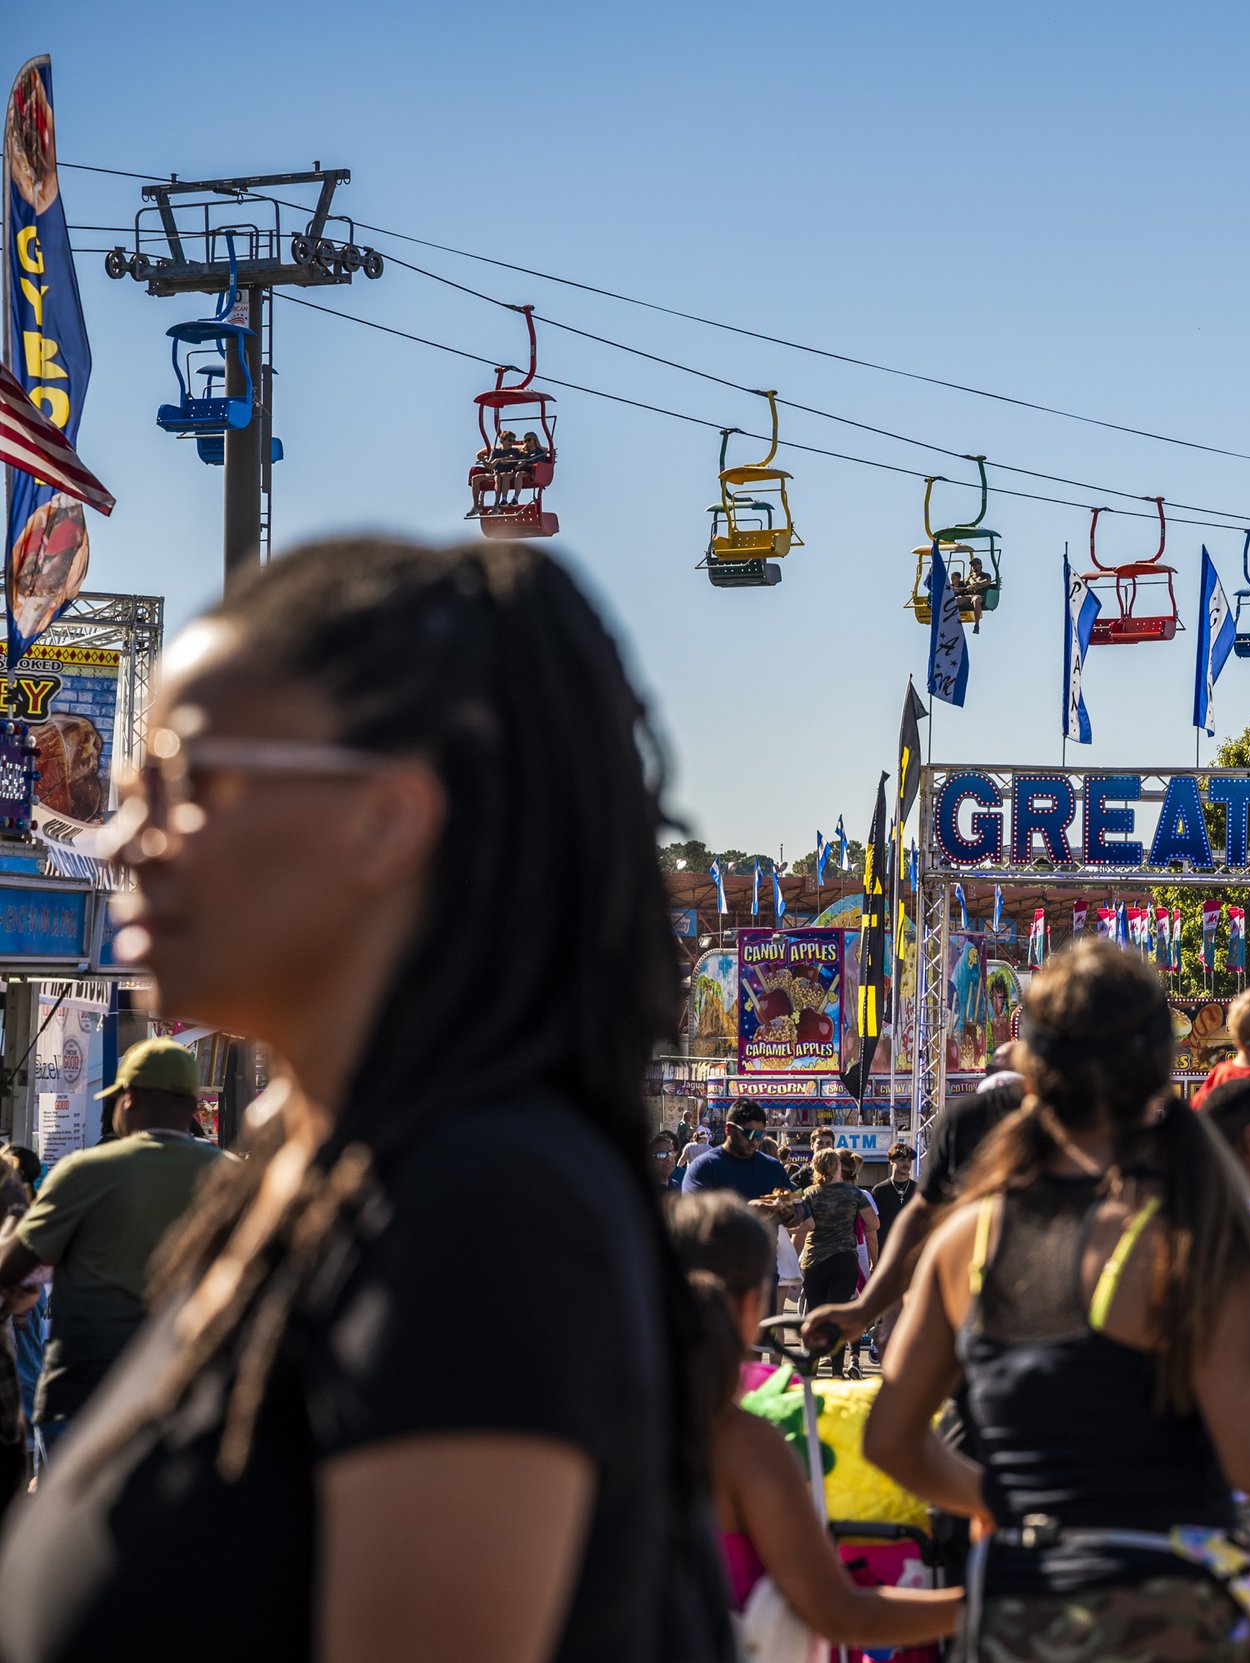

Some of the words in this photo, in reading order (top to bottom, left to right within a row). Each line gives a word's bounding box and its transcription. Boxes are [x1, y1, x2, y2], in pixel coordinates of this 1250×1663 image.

[743, 943, 786, 961] CANDY
[790, 943, 837, 961] APPLES
[745, 1042, 792, 1057] CARAMEL
[795, 1042, 833, 1056] APPLES
[738, 1082, 807, 1095] POPCORN
[836, 1134, 877, 1149] ATM
